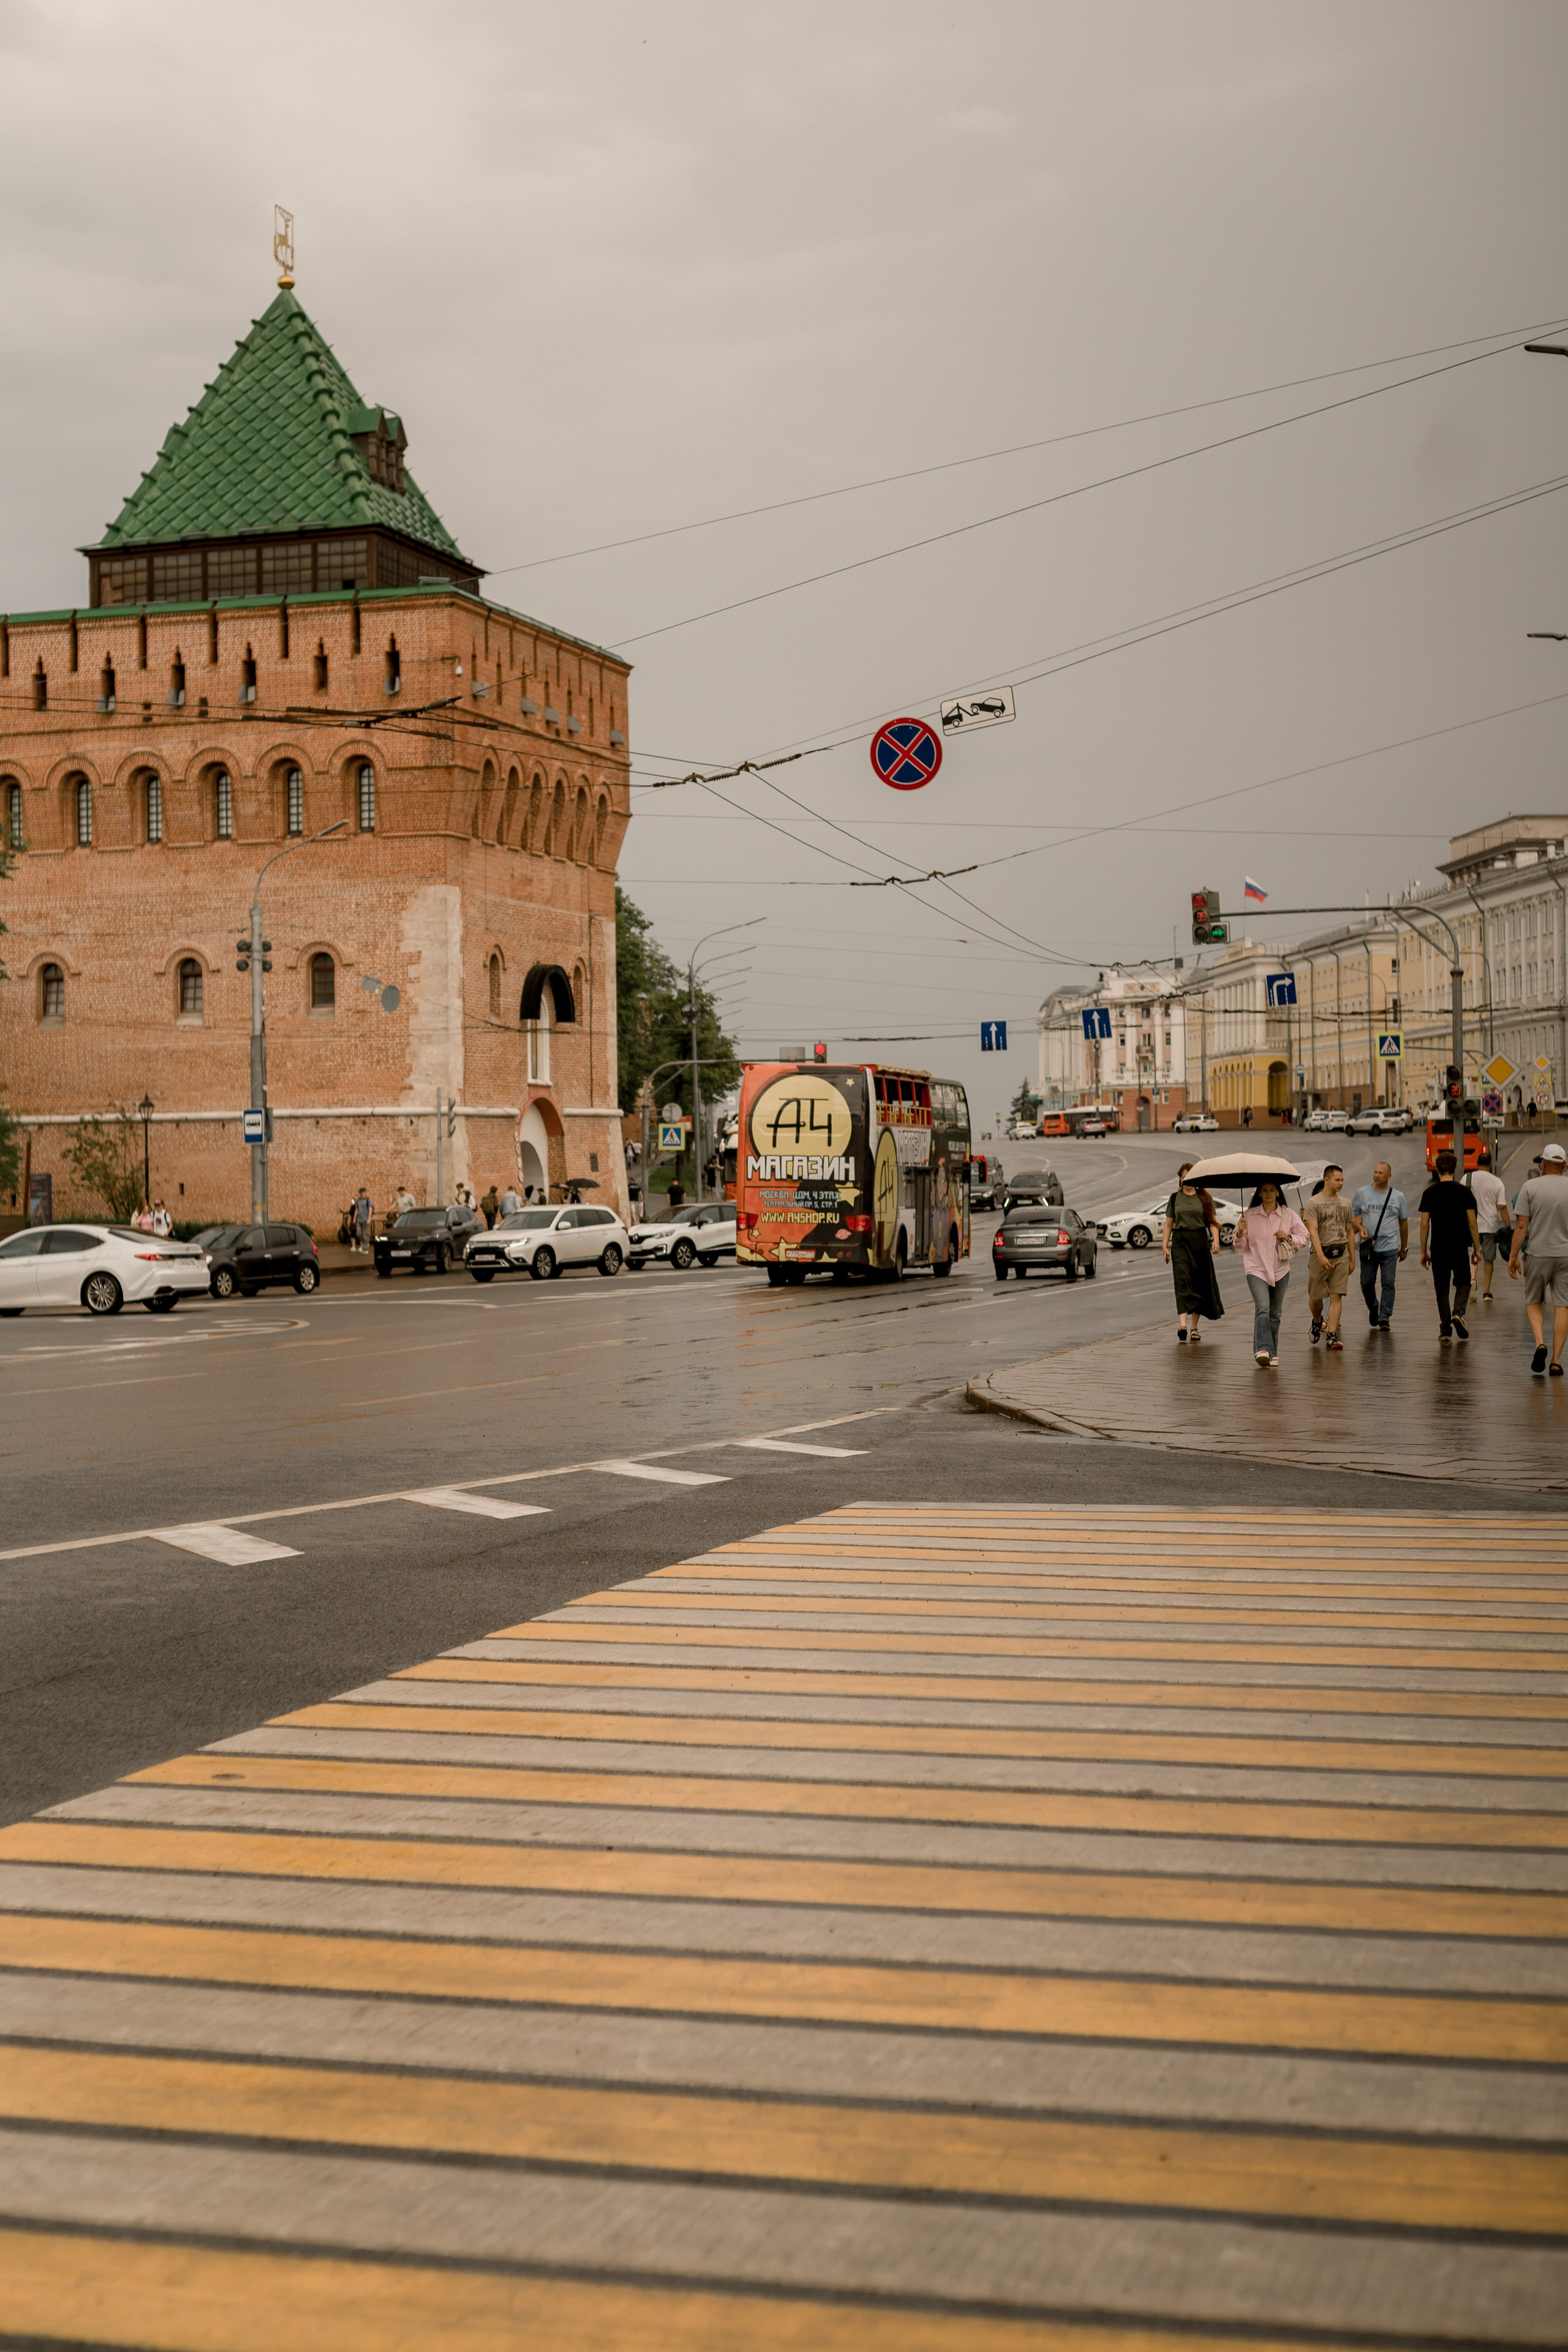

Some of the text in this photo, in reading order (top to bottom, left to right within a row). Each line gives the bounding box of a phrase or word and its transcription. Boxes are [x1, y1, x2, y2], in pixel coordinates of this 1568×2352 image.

[747, 1155, 856, 1181] МАГАЗИН
[760, 1191, 791, 1200] МОСКВА,
[792, 1191, 812, 1200] ЦДМ,
[819, 1191, 841, 1199] ЭТАЖ
